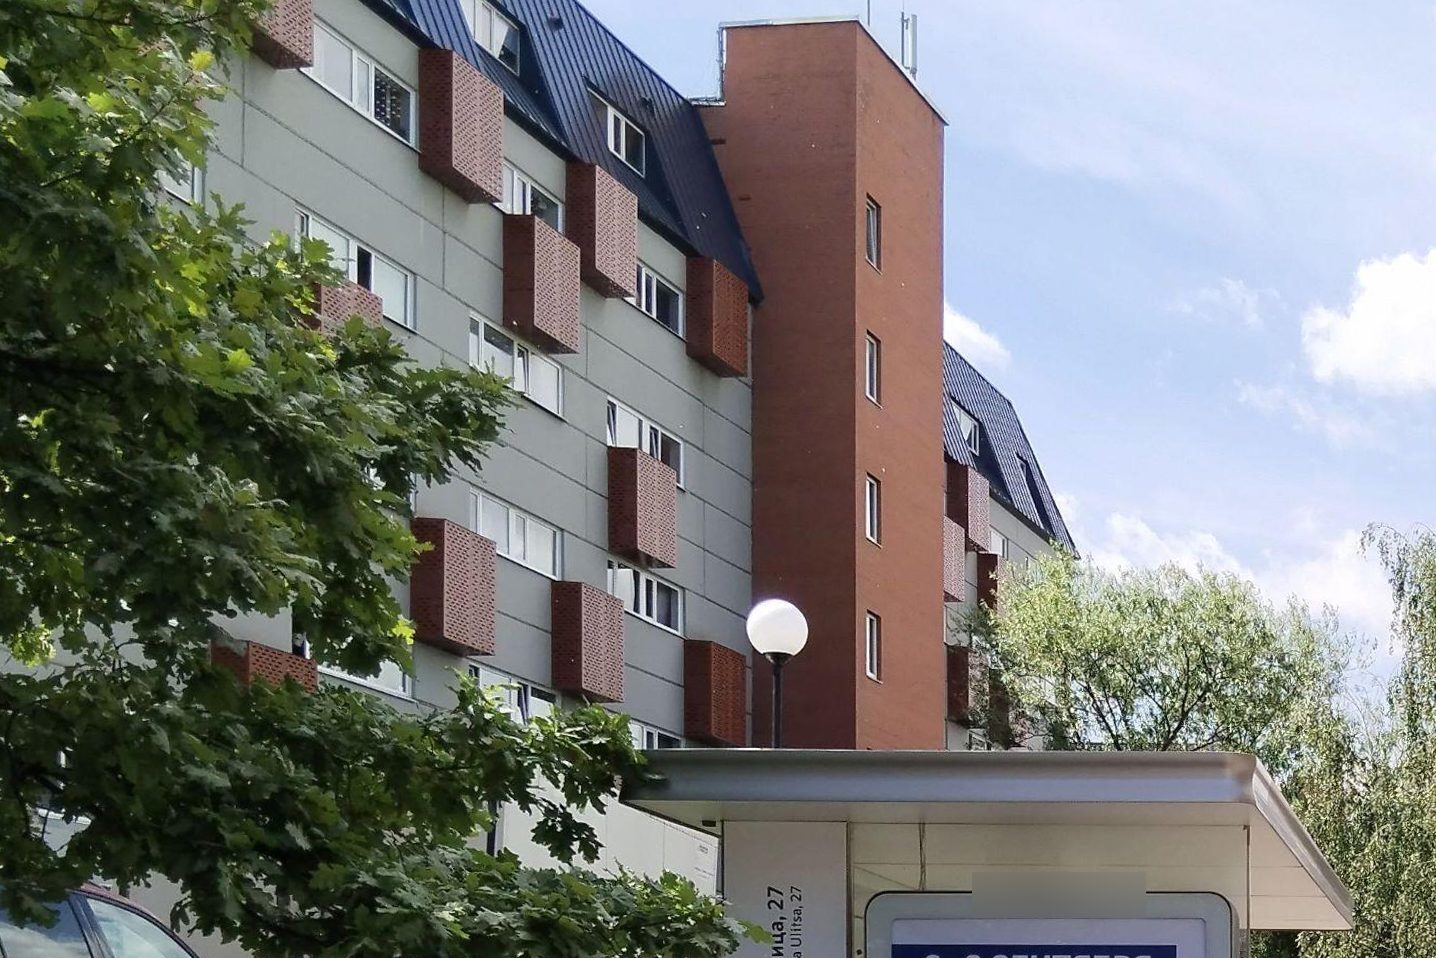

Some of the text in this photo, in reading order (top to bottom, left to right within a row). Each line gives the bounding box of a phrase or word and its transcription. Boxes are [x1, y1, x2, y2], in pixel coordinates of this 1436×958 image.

[767, 886, 784, 911] 27
[790, 885, 803, 903] 27
[790, 905, 805, 948] Ulitsa,
